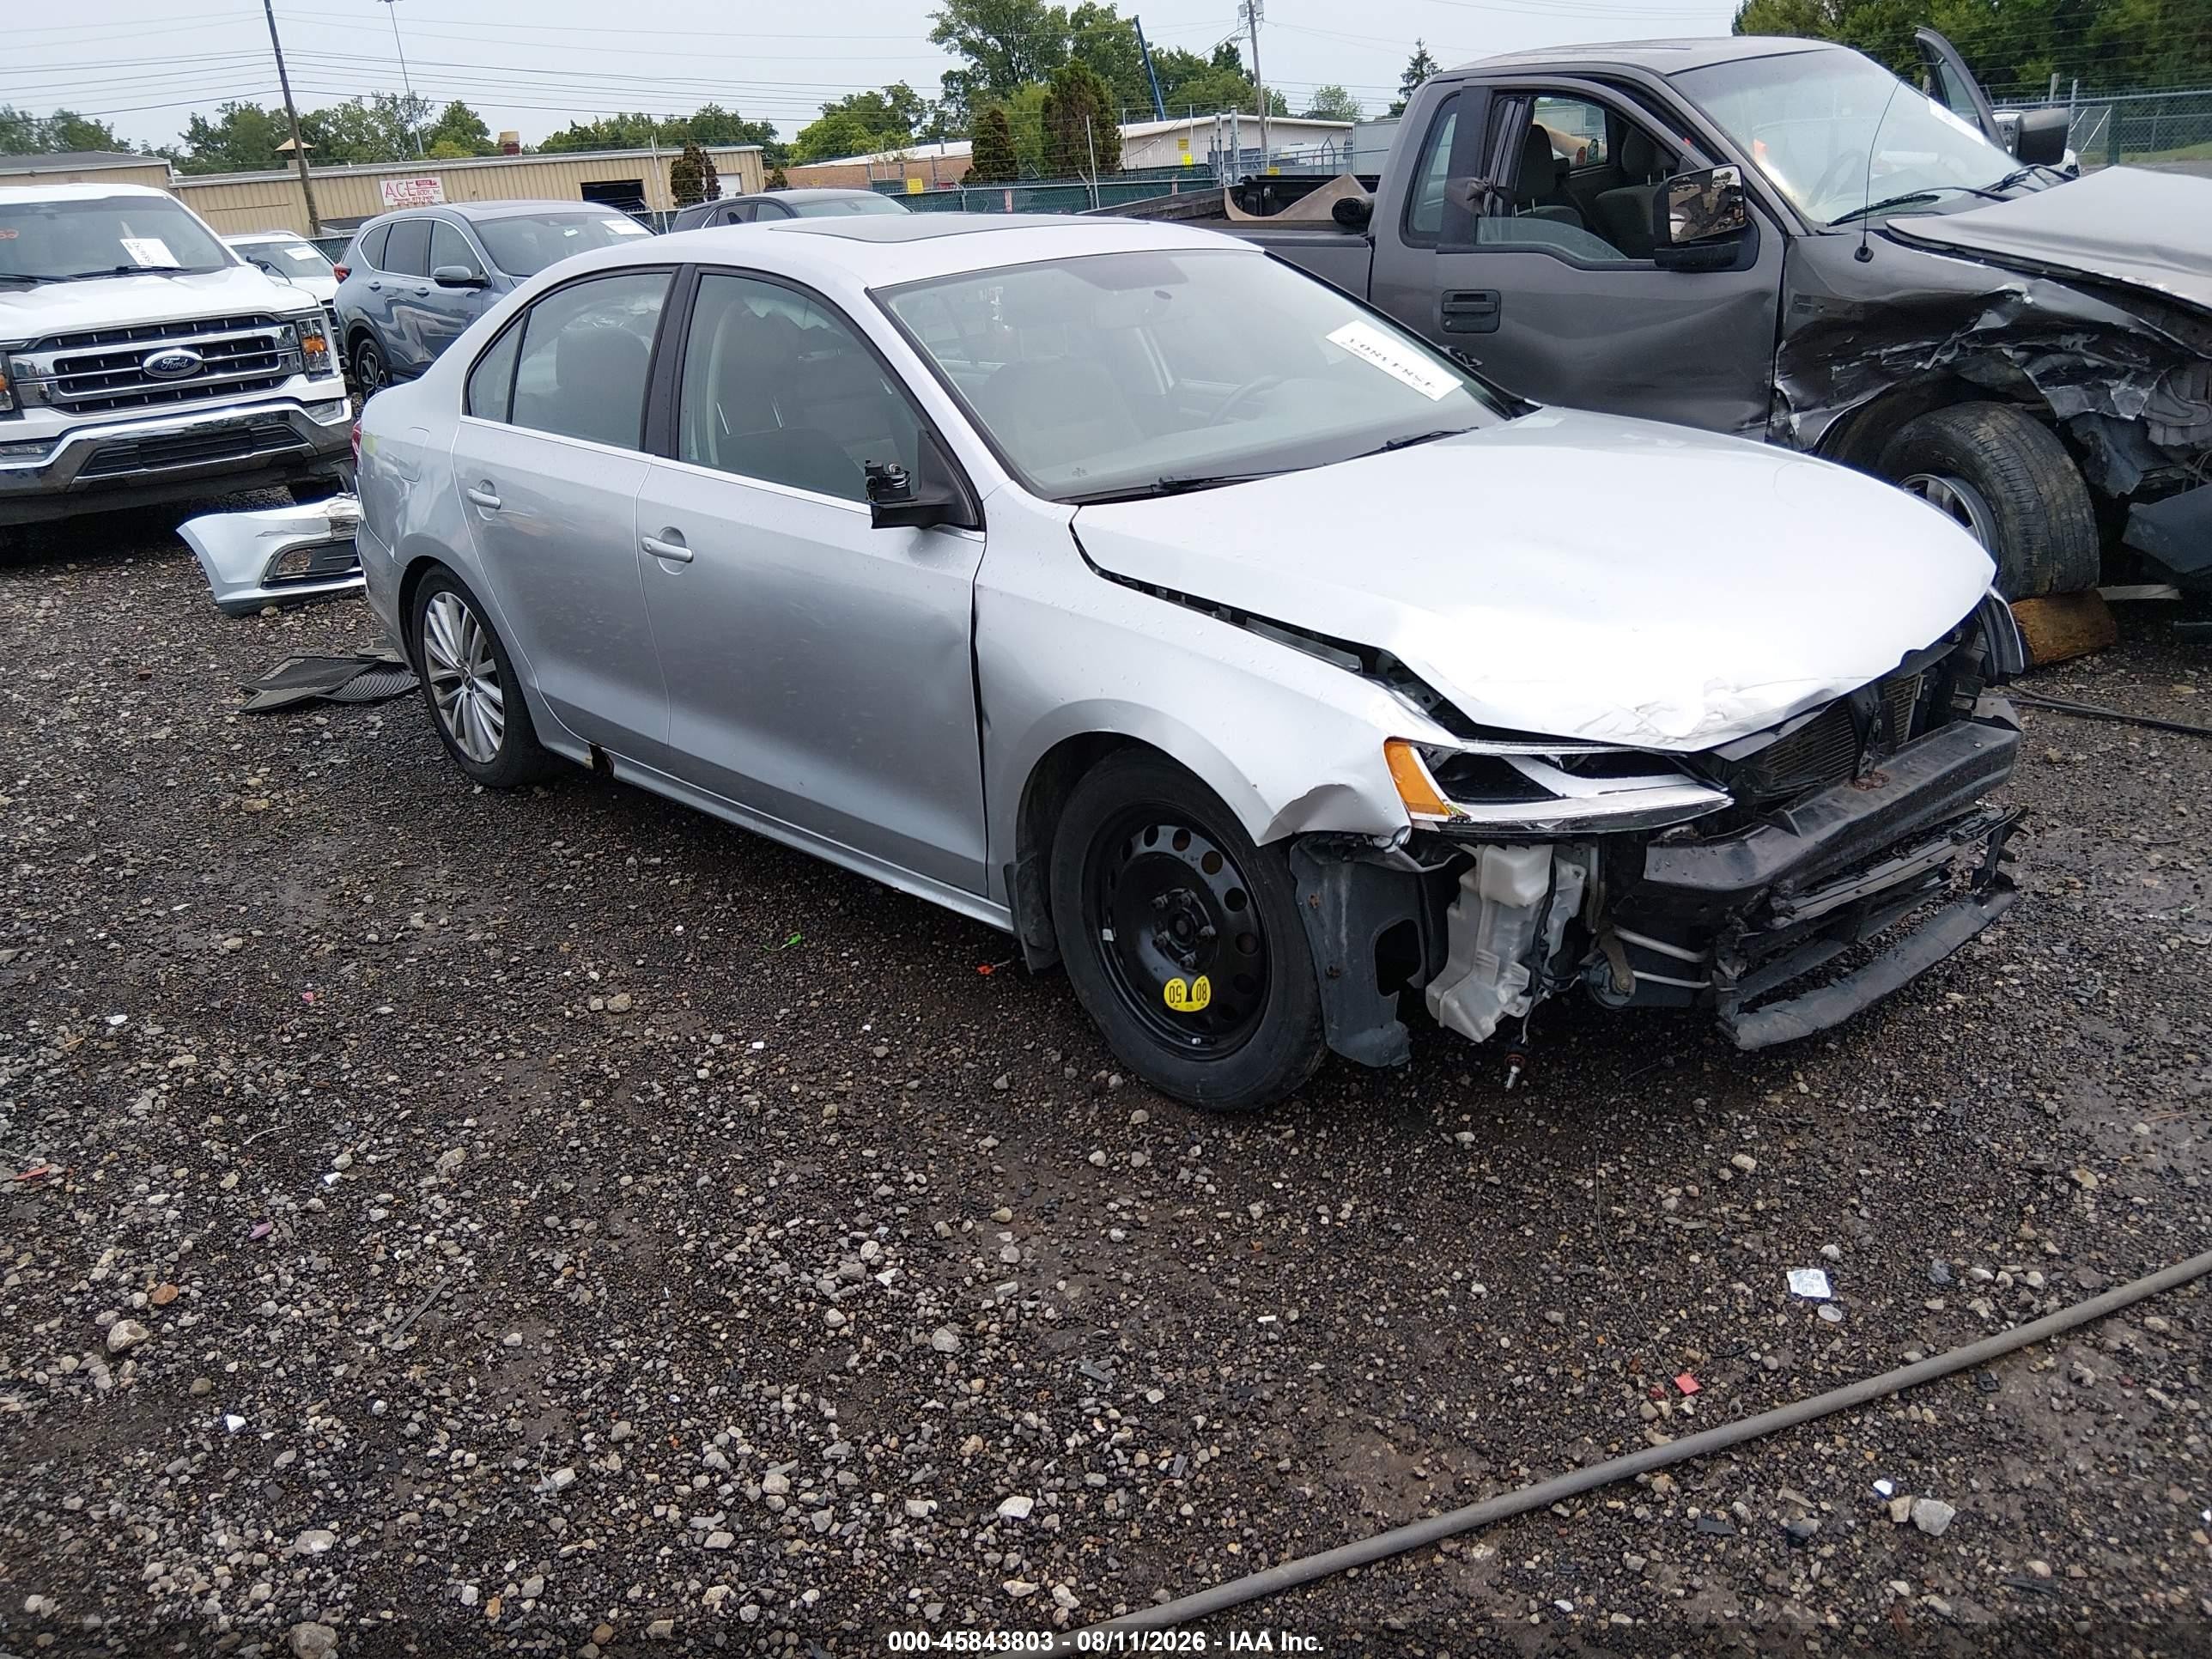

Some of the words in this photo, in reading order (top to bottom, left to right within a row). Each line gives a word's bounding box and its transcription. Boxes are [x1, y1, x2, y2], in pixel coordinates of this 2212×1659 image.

[386, 180, 416, 198] ACE
[161, 356, 188, 370] Ford
[1169, 985, 1182, 1004] 50
[1196, 983, 1207, 1002] 80
